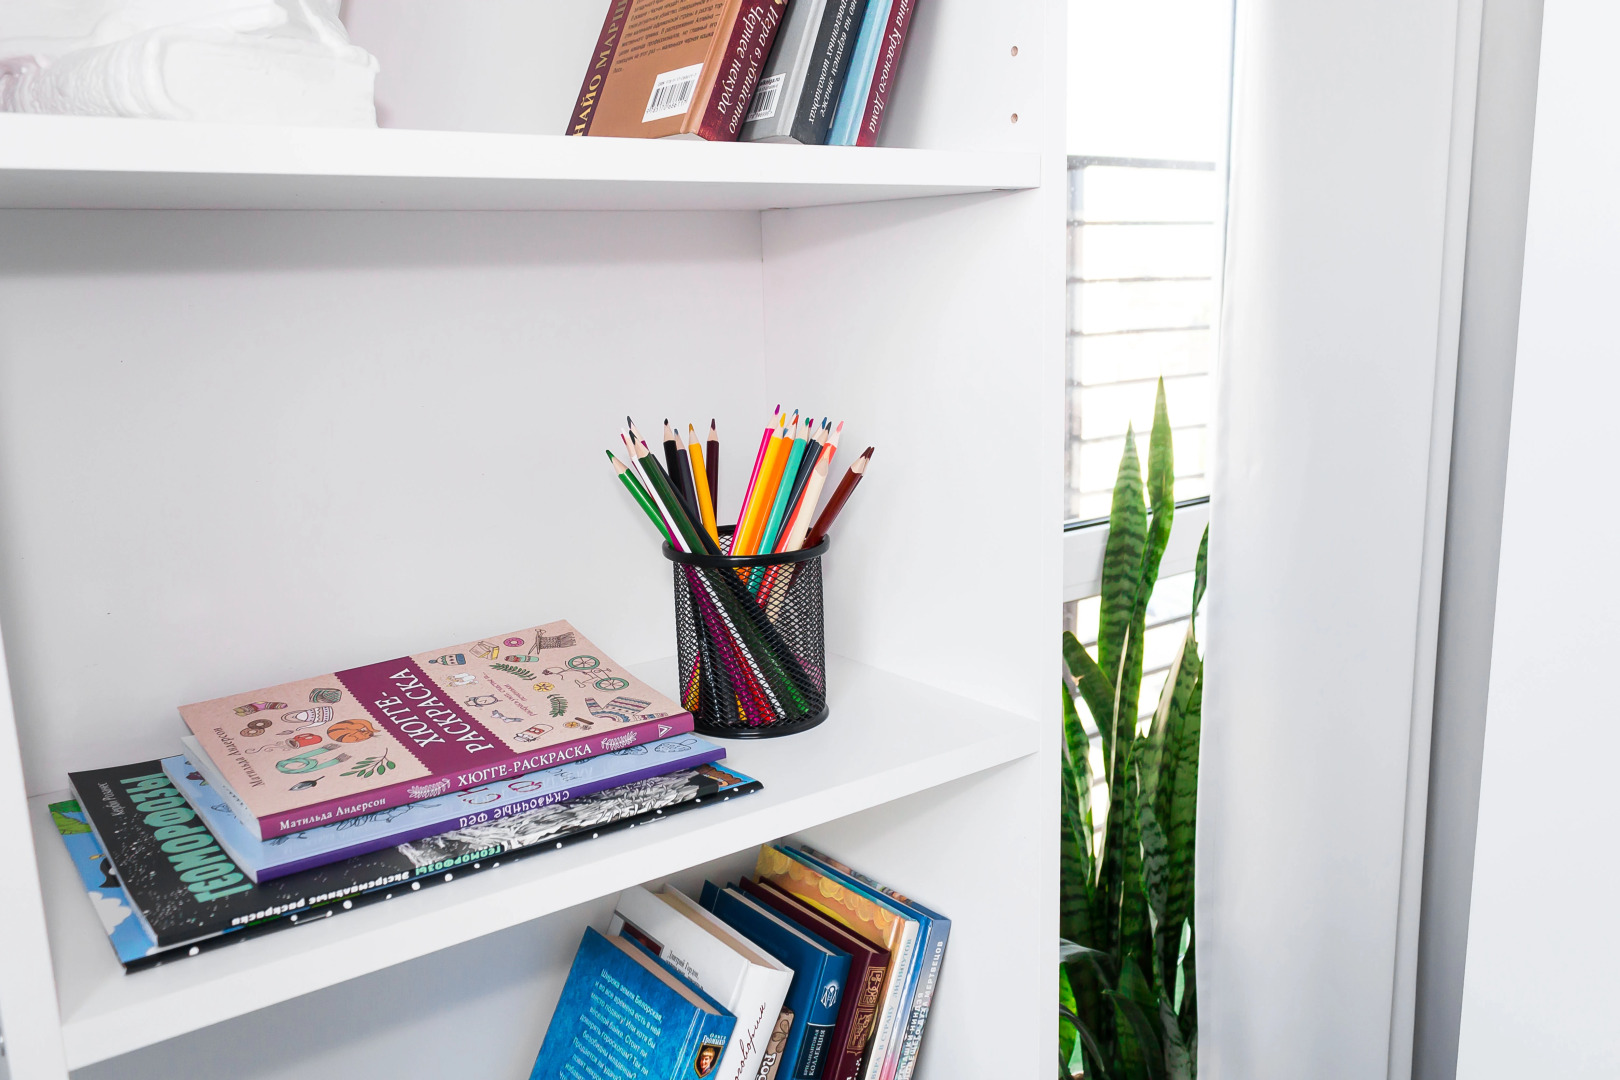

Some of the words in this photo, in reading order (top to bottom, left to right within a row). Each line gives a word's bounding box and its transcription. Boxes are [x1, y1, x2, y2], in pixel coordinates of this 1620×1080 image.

[737, 6, 764, 59] Чернее
[758, 5, 779, 47] Игра
[826, 0, 847, 59] равленных
[843, 16, 852, 31] на
[573, 74, 602, 137] НАЙО
[596, 0, 629, 70] МАРШ
[754, 47, 762, 59] в
[832, 31, 848, 76] верхнем
[879, 27, 902, 93] Красного
[717, 58, 742, 114] некуда
[729, 54, 759, 134] убийство
[808, 58, 830, 125] шоколадках
[820, 77, 835, 118] этаже
[868, 91, 885, 133] Дома
[374, 691, 446, 748] ХЮГГЕ-
[389, 668, 495, 754] РАСКРАСКА
[457, 743, 592, 787] ХЮГГЕ-РАСКРАСКА
[120, 772, 253, 904] ГЕОМОРФОЗЫ
[280, 812, 333, 831] Матильда
[336, 797, 386, 818] Андерсон
[924, 941, 944, 998] МЕРТВЕЦОВ
[808, 1029, 826, 1076] КОЛЛЕКЦИЯ
